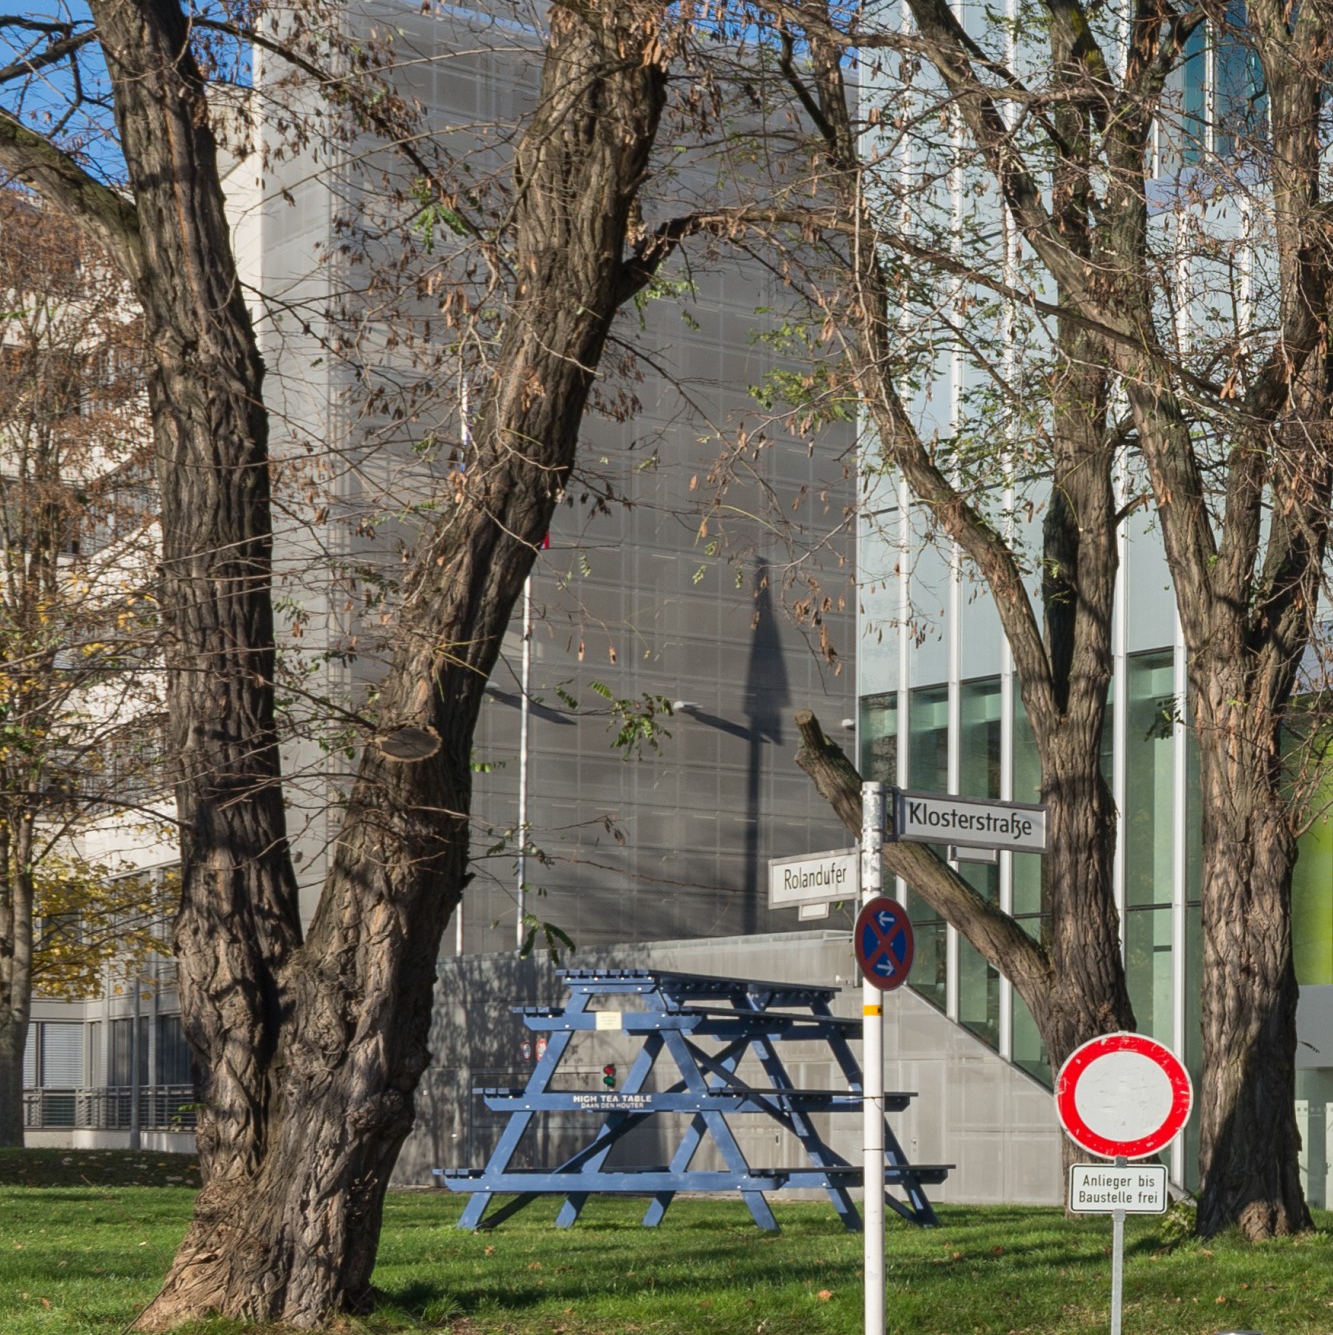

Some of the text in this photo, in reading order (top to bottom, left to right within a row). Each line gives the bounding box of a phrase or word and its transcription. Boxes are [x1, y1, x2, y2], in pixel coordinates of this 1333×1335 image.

[909, 801, 1032, 839] Klosterstraße
[784, 862, 847, 890] Rolandufer
[573, 1095, 652, 1103] HIGH TEA TABLE
[1082, 1174, 1155, 1190] Anlieger bis
[1079, 1190, 1158, 1203] Baustelle frei
